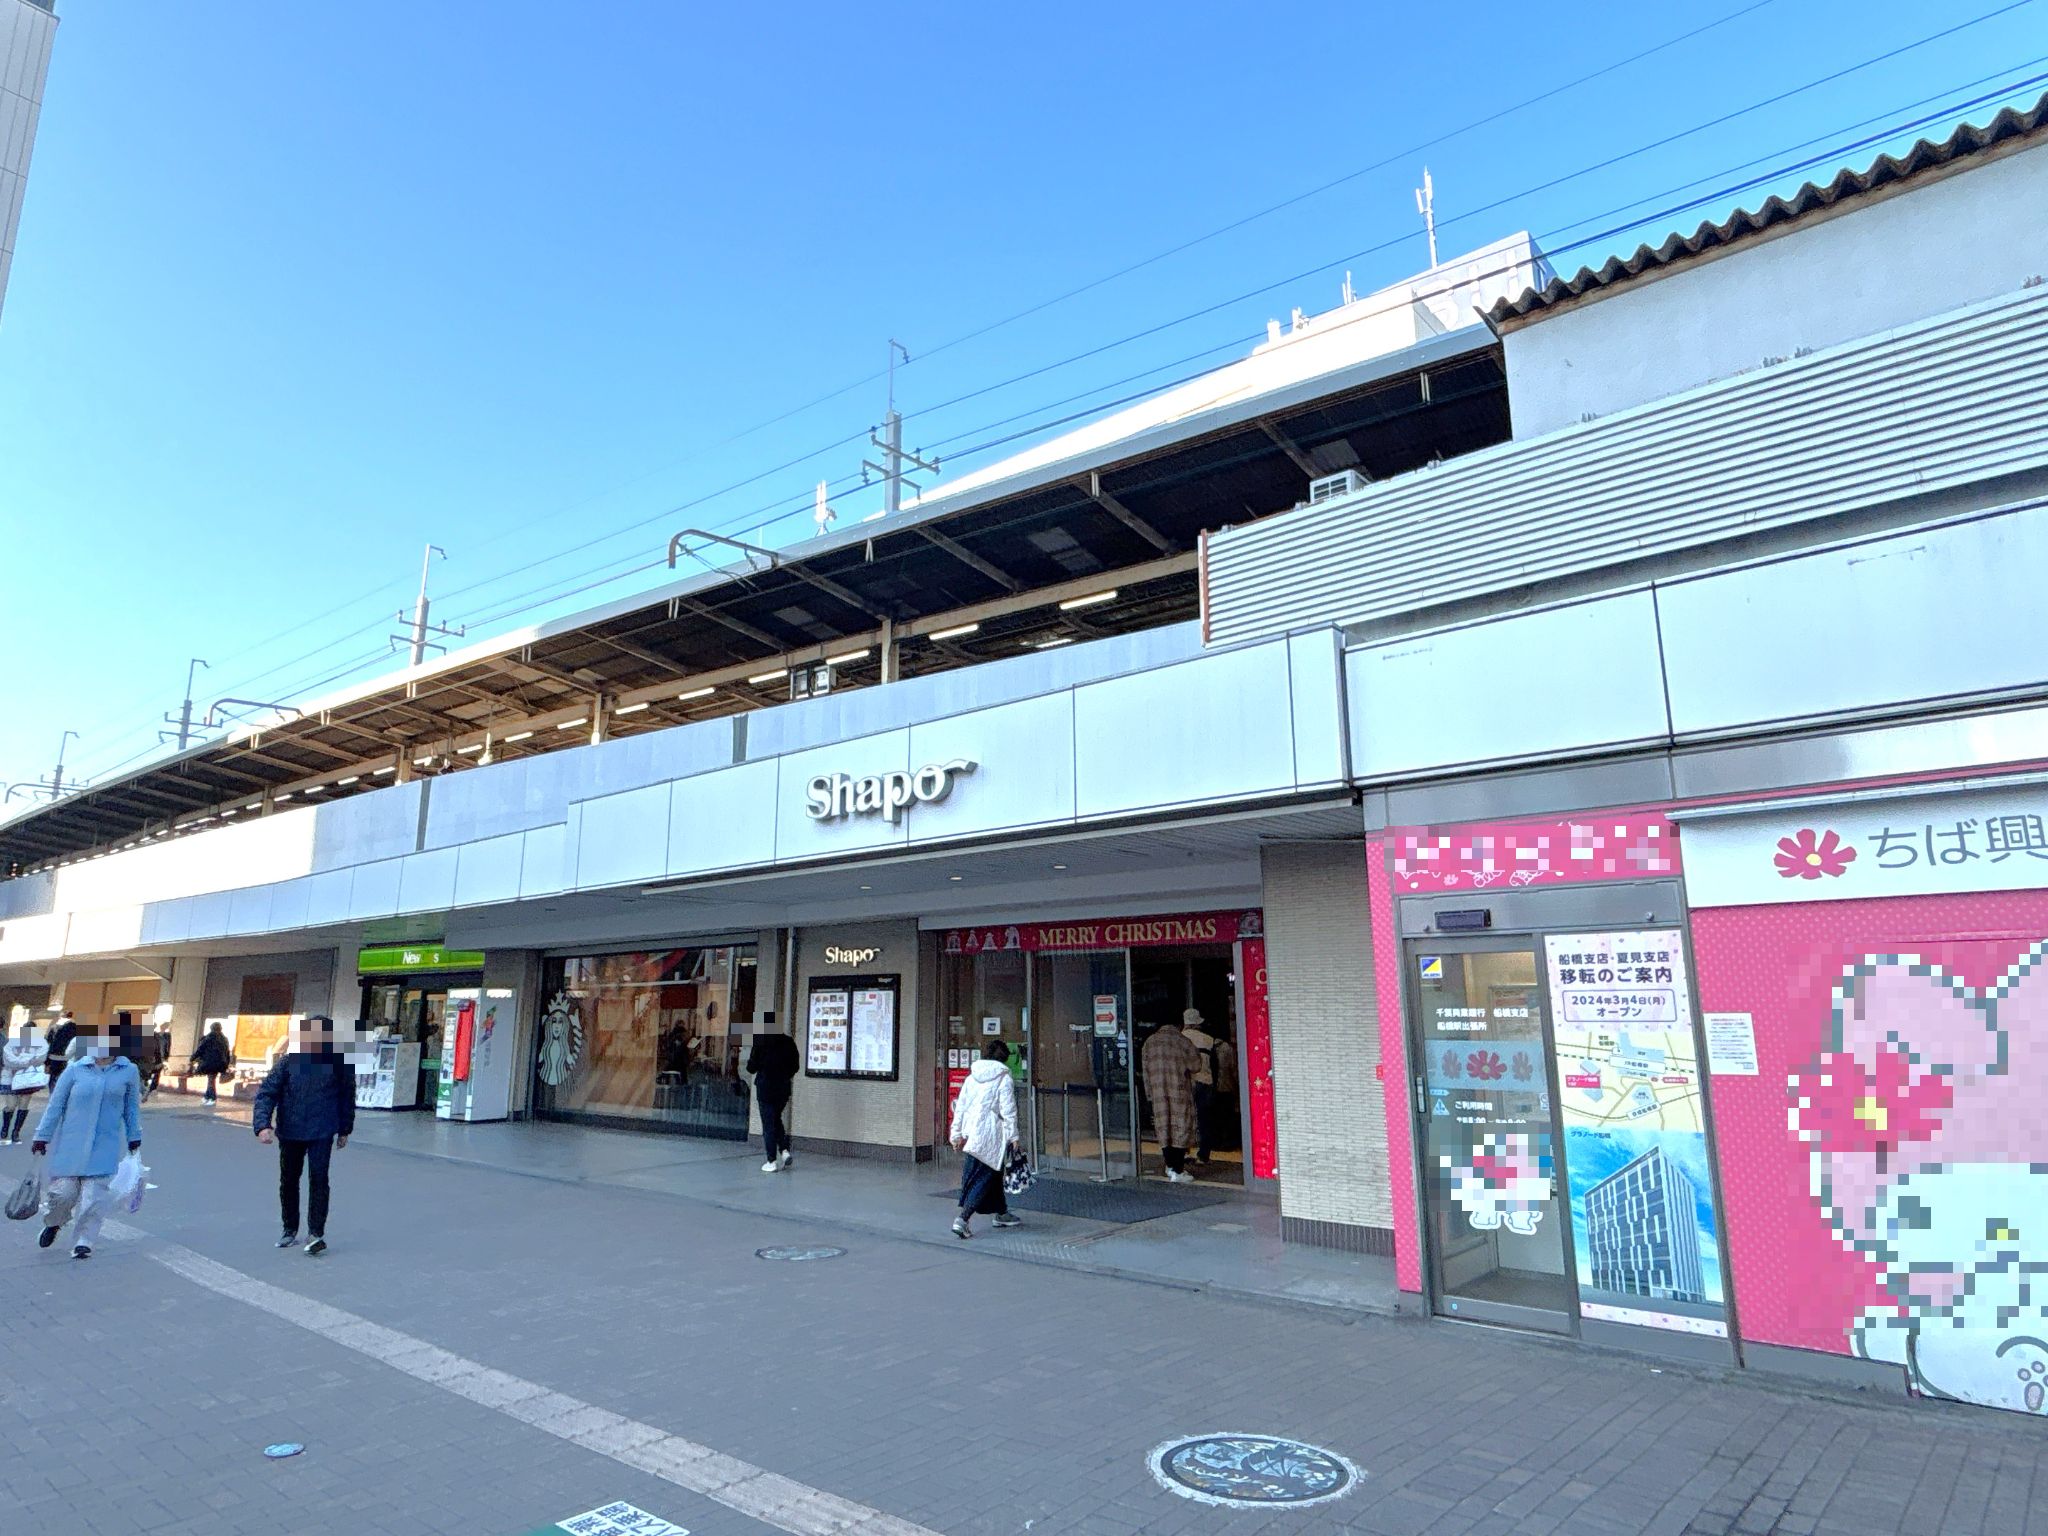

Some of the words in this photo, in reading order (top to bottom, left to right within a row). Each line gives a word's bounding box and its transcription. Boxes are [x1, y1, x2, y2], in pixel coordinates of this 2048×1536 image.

[806, 759, 978, 824] Shapo
[1868, 814, 2048, 868] ちば興
[1039, 926, 1100, 945] MERRY
[1104, 918, 1217, 942] CHRISTMAS
[825, 946, 880, 967] Shapo
[1558, 951, 1670, 965] 船橋支店・夏見支店
[1560, 966, 1672, 984] 移転のご案内
[1571, 995, 1666, 1006] 2024年3月4日(月)
[1596, 1007, 1642, 1017] オープン
